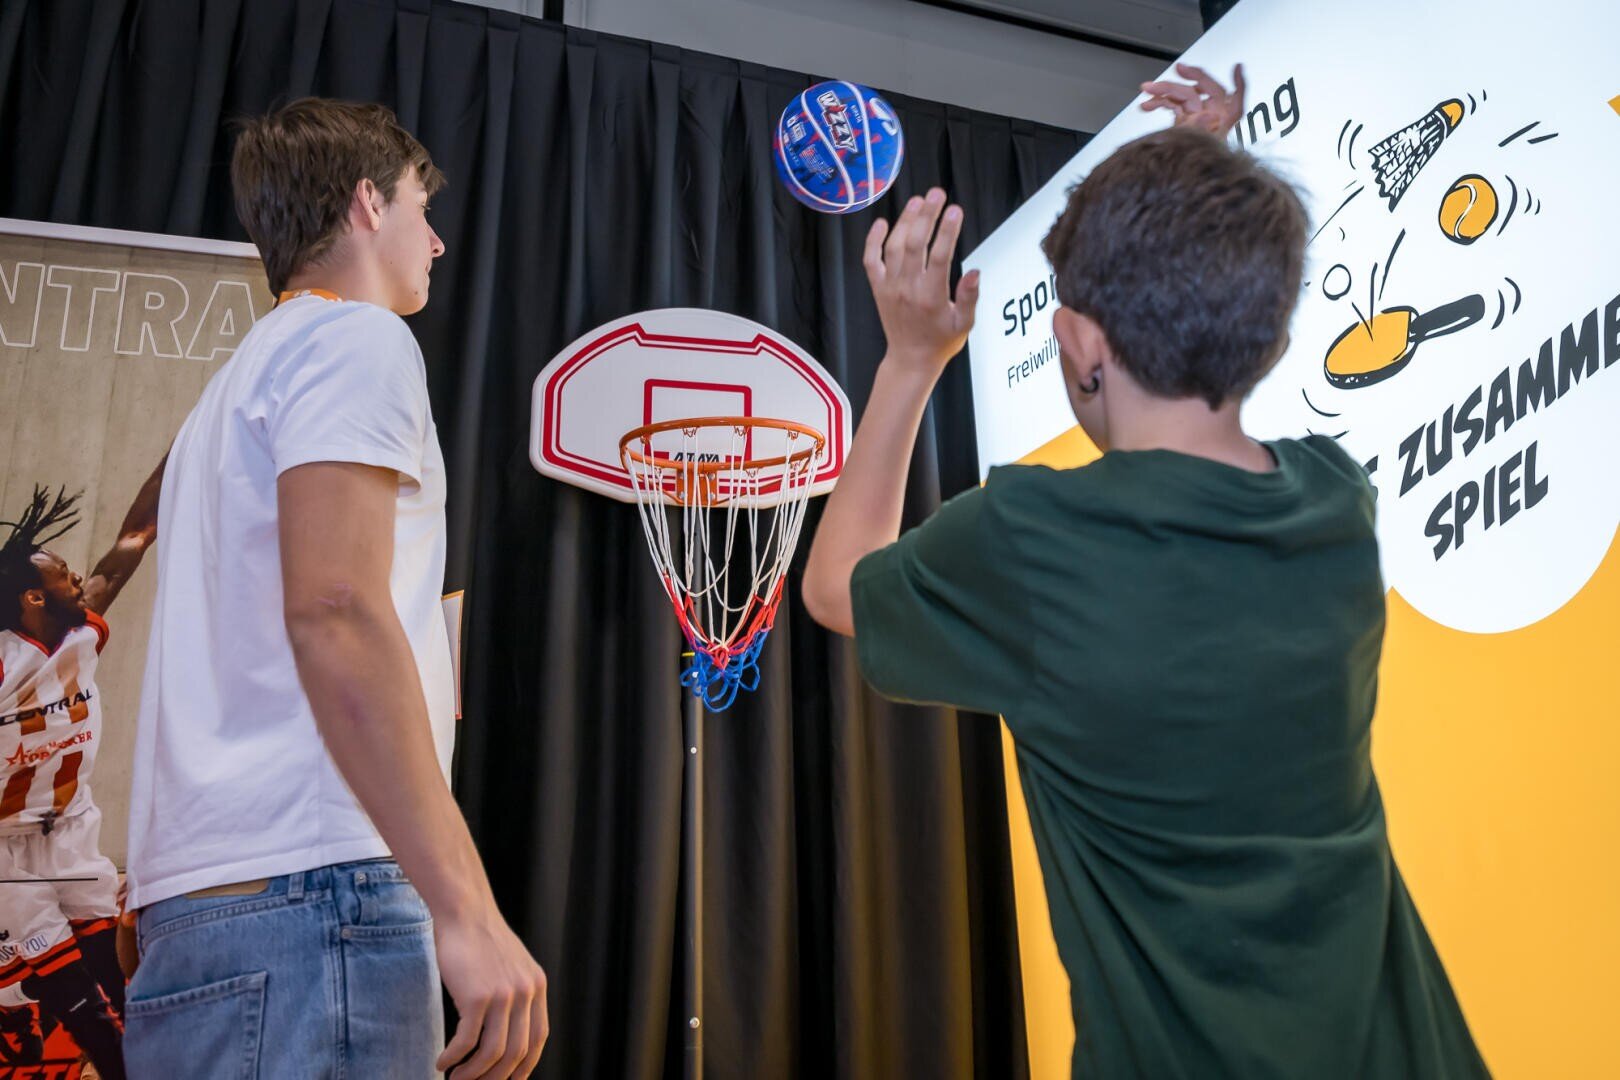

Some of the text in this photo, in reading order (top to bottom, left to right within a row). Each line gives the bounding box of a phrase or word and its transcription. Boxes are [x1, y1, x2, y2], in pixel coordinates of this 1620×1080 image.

[817, 90, 858, 153] WIZZY
[1424, 440, 1549, 561] SPIEL
[22, 934, 48, 954] YOU
